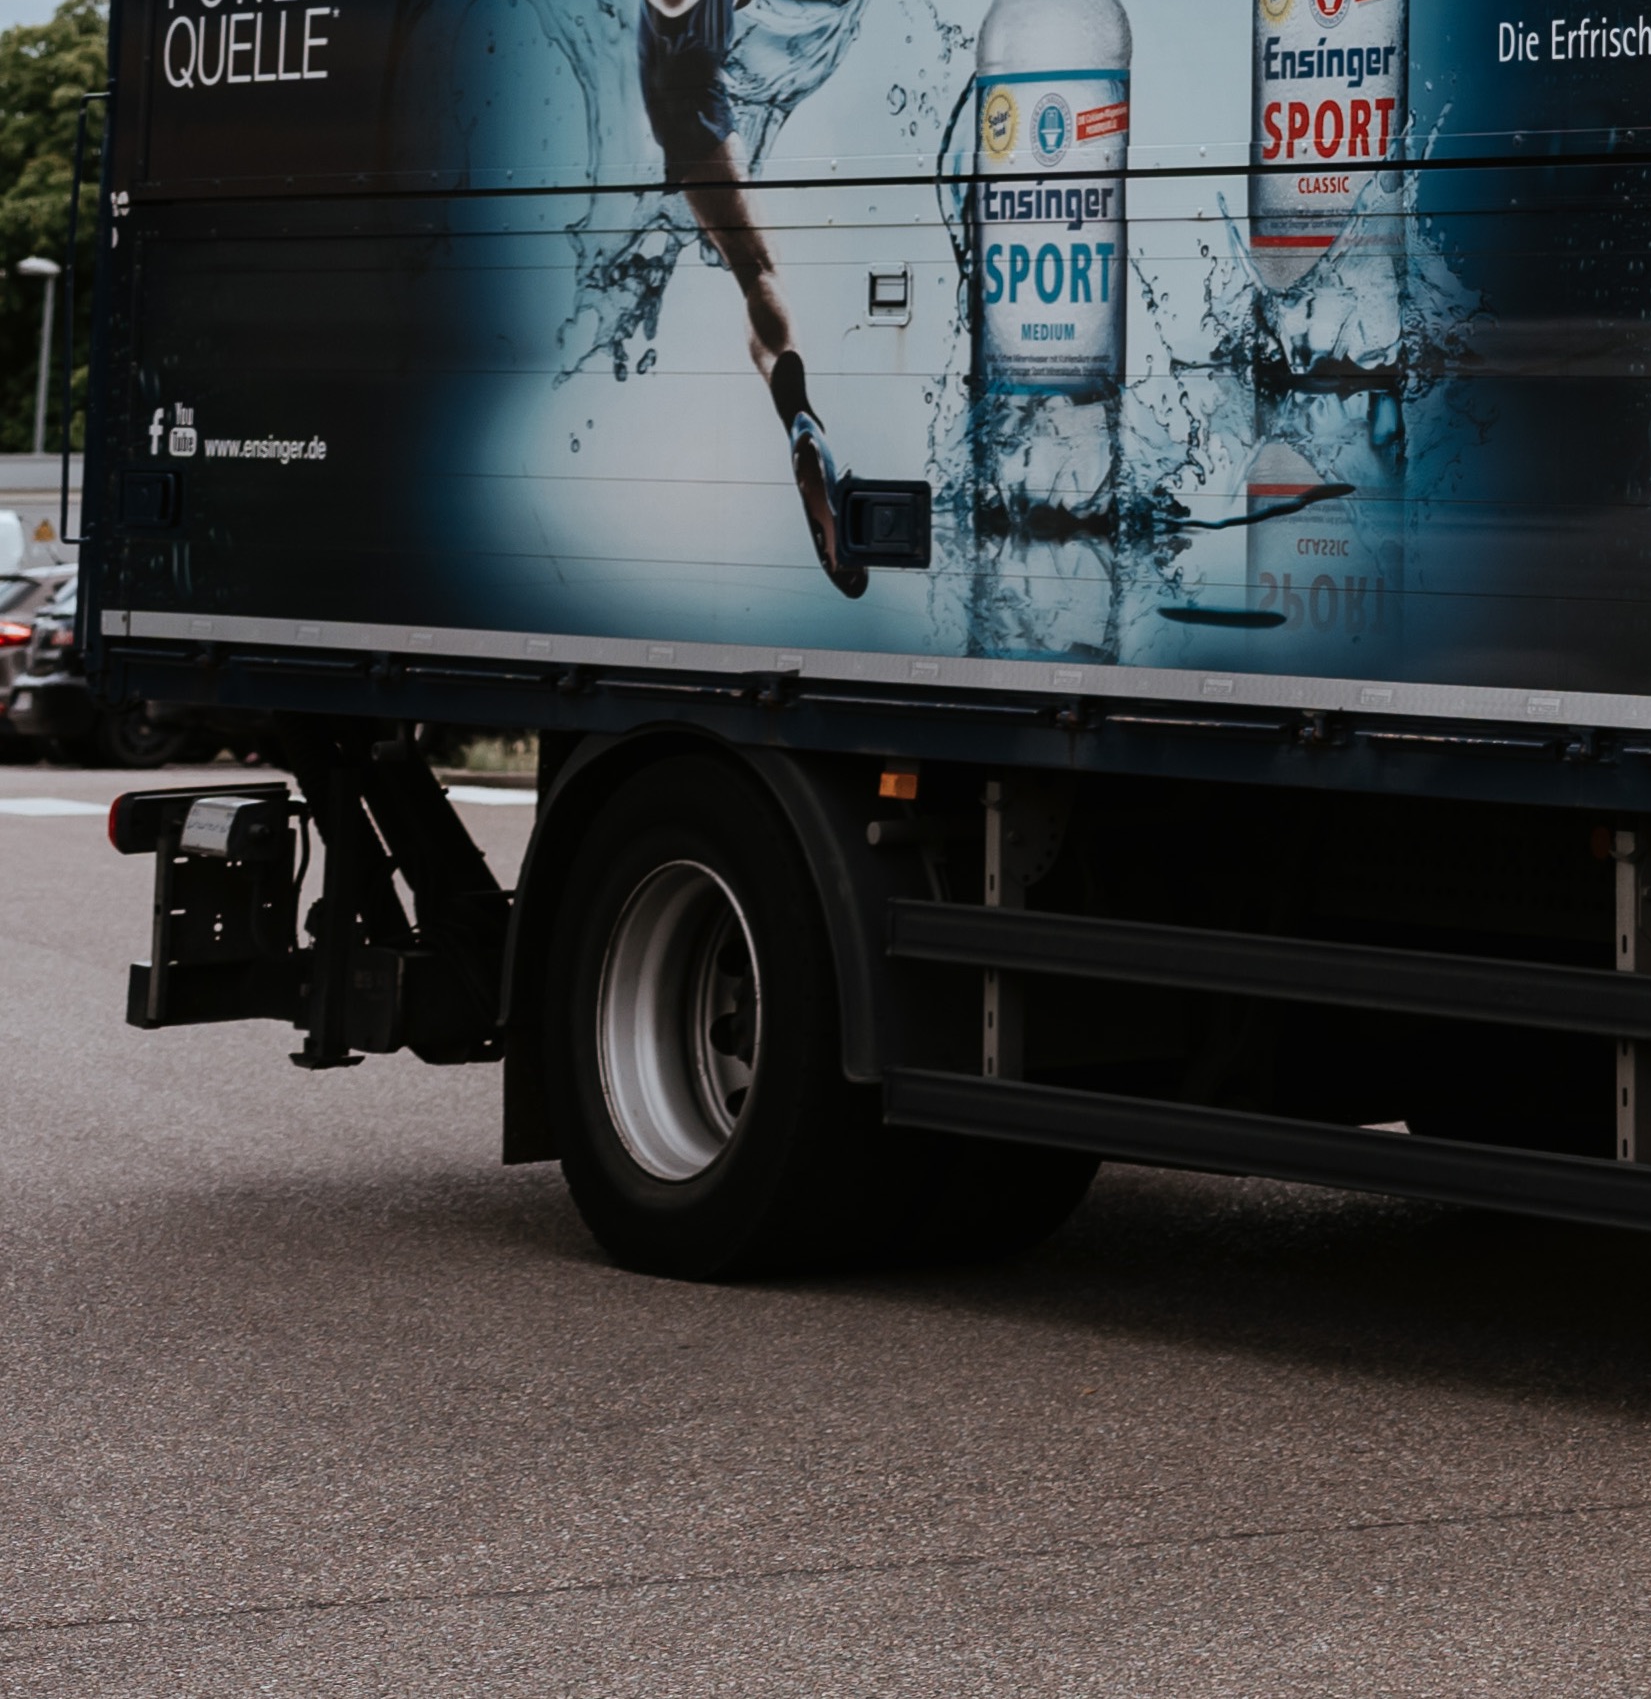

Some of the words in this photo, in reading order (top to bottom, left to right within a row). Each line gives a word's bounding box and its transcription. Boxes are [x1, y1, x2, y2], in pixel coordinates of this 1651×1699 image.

[1263, 36, 1396, 88] Ensinger
[1498, 22, 1539, 62] Die
[1262, 97, 1395, 160] SPORT
[983, 181, 1113, 231] Ensinger
[1298, 176, 1350, 194] CLASSIC
[985, 242, 1115, 304] SPORT
[1021, 323, 1075, 341] MEDIUM
[204, 434, 327, 464] www.ensinger.de
